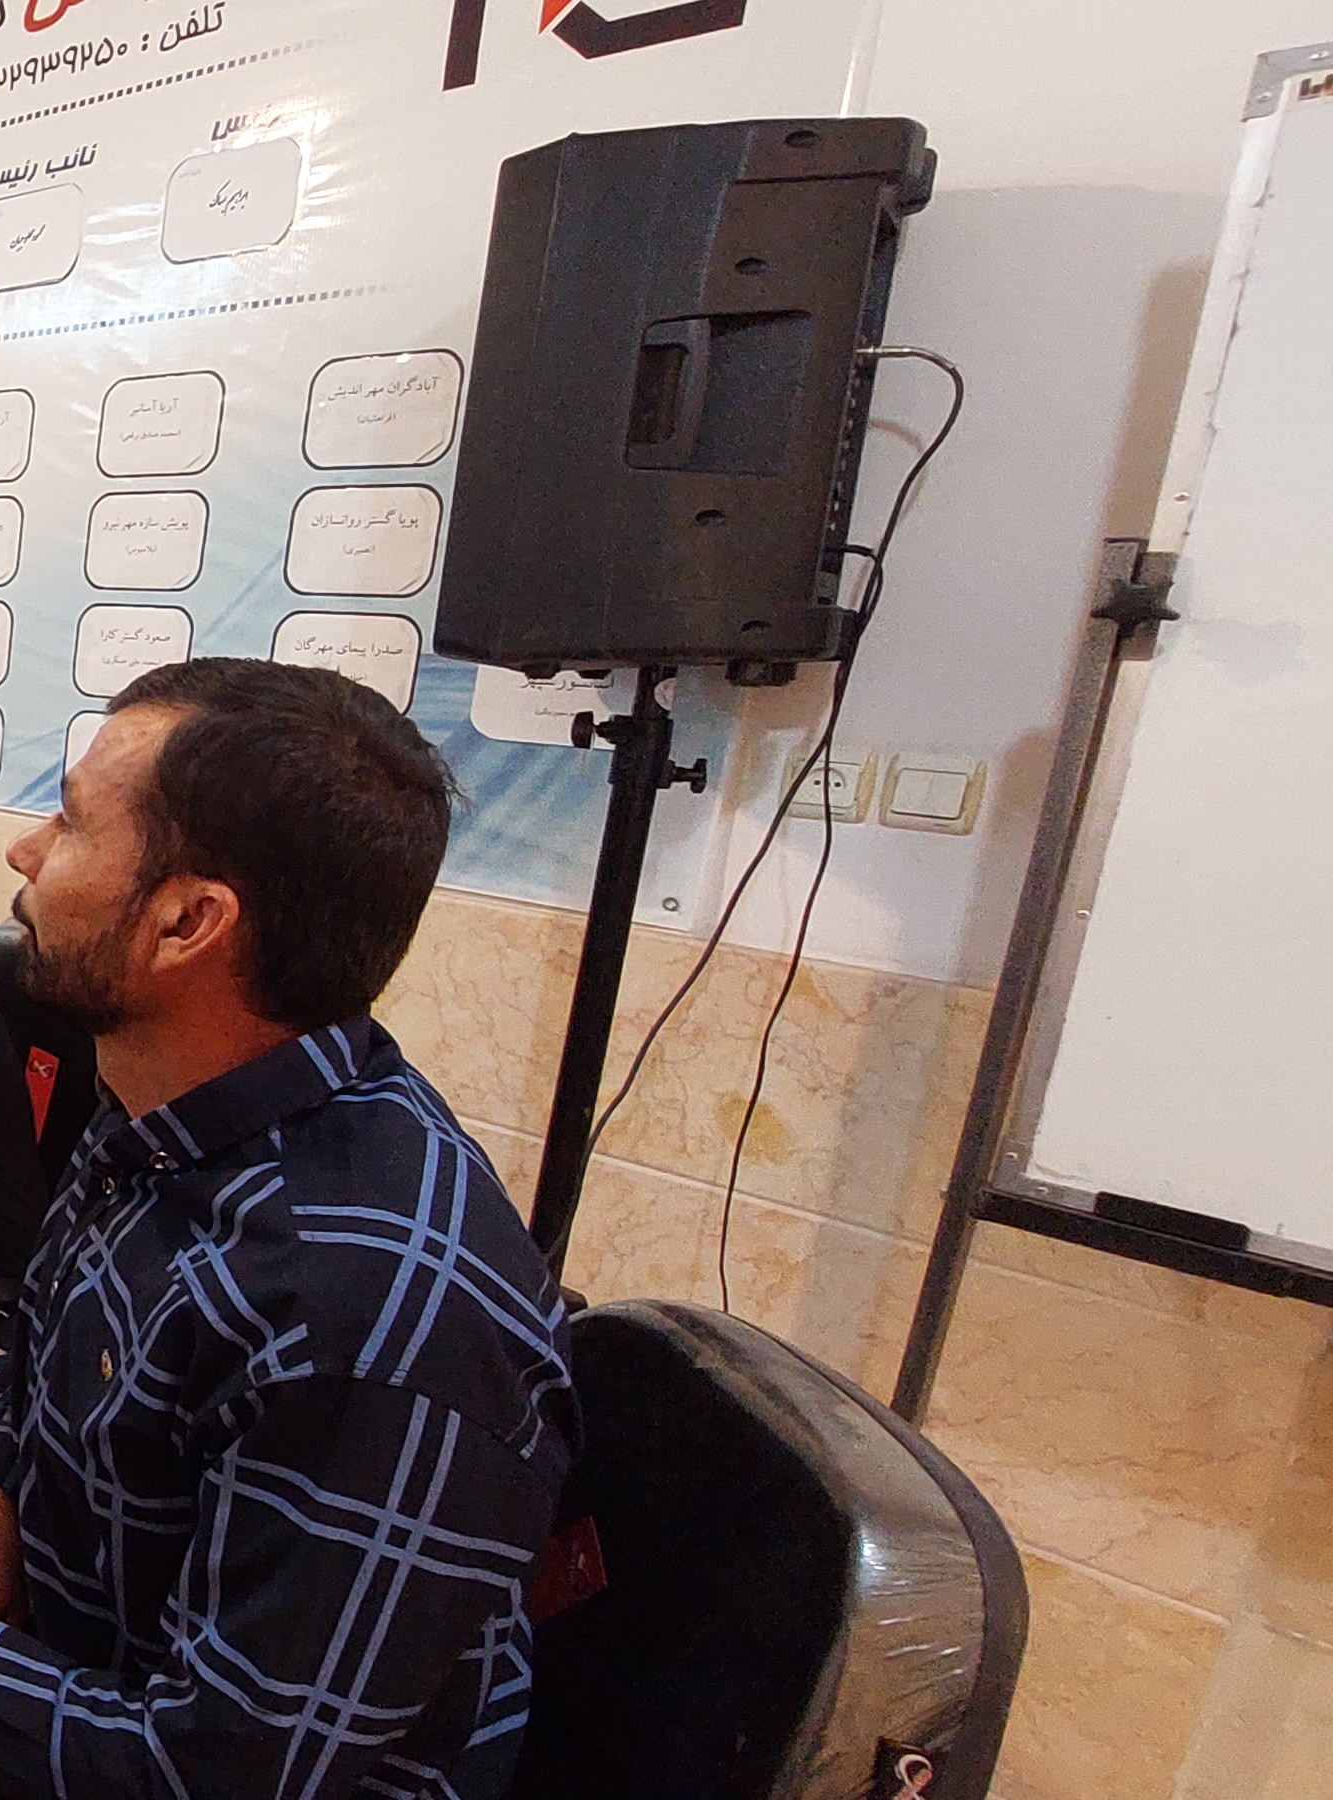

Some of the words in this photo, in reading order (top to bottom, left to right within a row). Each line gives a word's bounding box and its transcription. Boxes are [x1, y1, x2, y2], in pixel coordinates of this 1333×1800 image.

[159, 1, 226, 52] تلفن
[45, 143, 97, 179] نائب
[363, 386, 385, 399] مهر
[121, 520, 138, 532] مهر
[364, 509, 397, 529] گستر
[398, 511, 419, 529] پویا
[119, 627, 144, 644] گستر
[144, 633, 172, 645] صعود
[371, 641, 403, 657] صدرا
